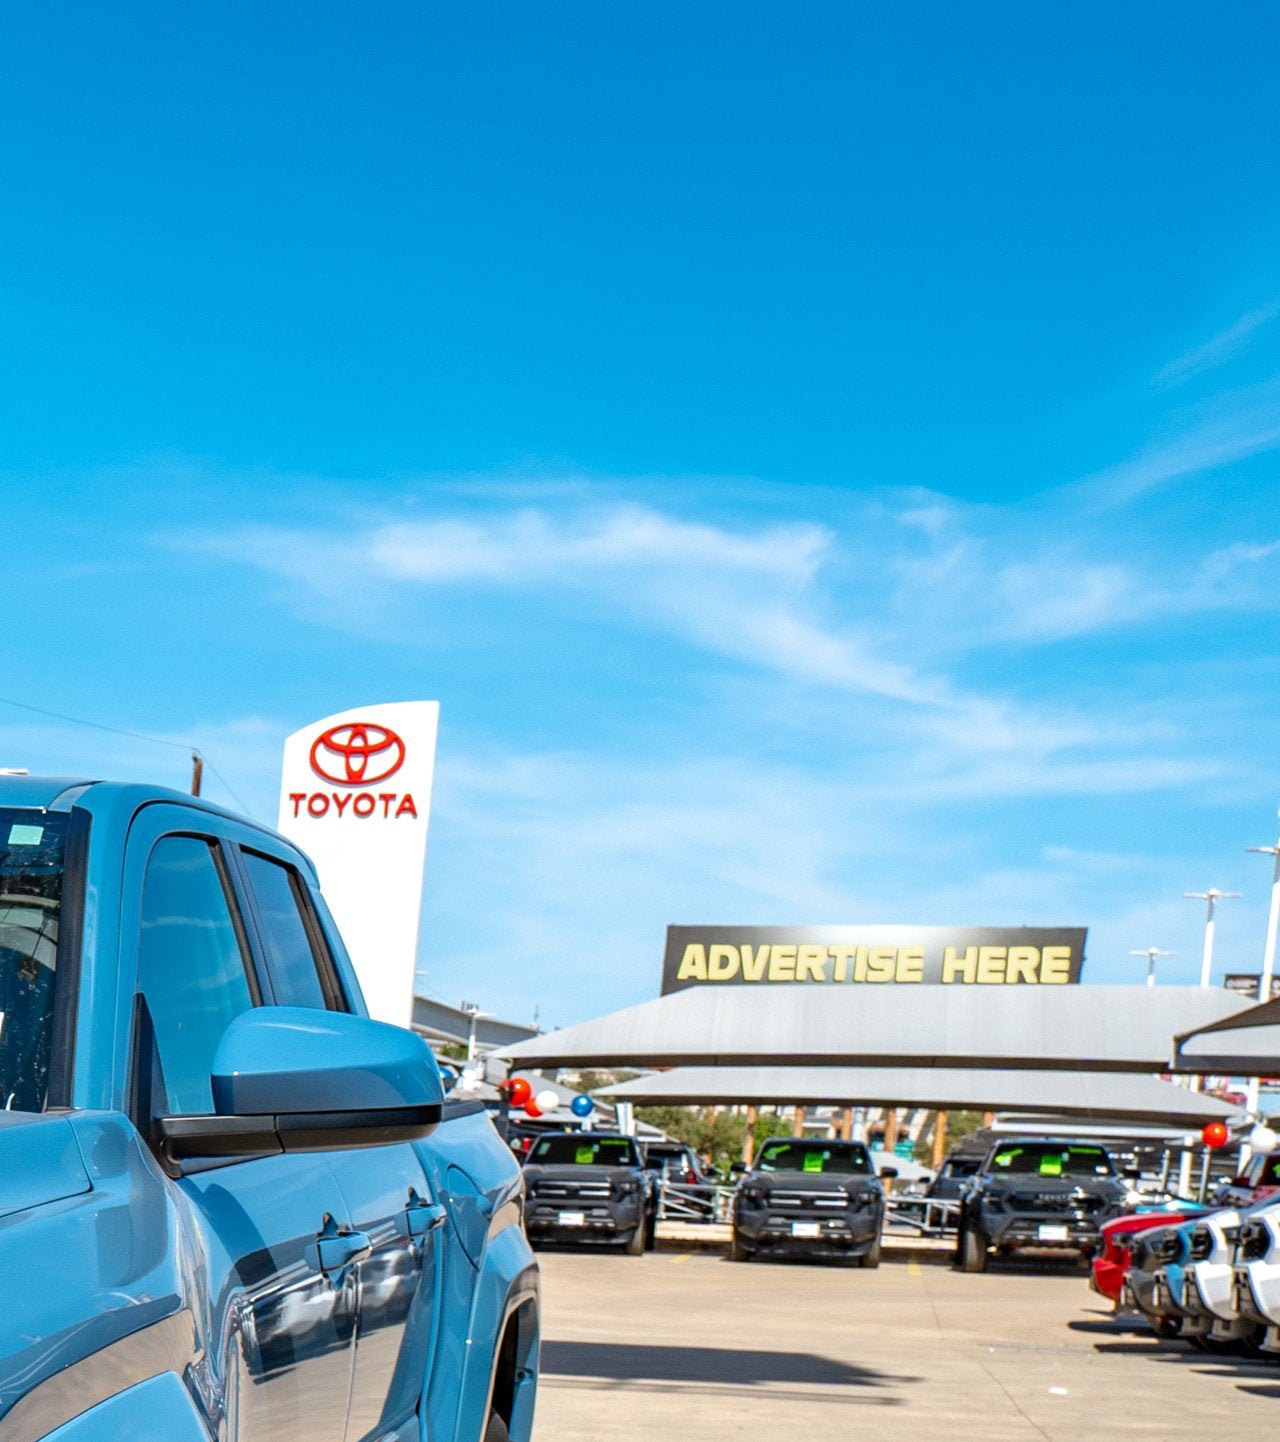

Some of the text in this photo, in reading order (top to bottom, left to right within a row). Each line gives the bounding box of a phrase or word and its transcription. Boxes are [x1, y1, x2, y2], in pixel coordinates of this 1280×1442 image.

[289, 792, 418, 819] TOYOTA
[677, 943, 1072, 985] ADVERTISE HERE
